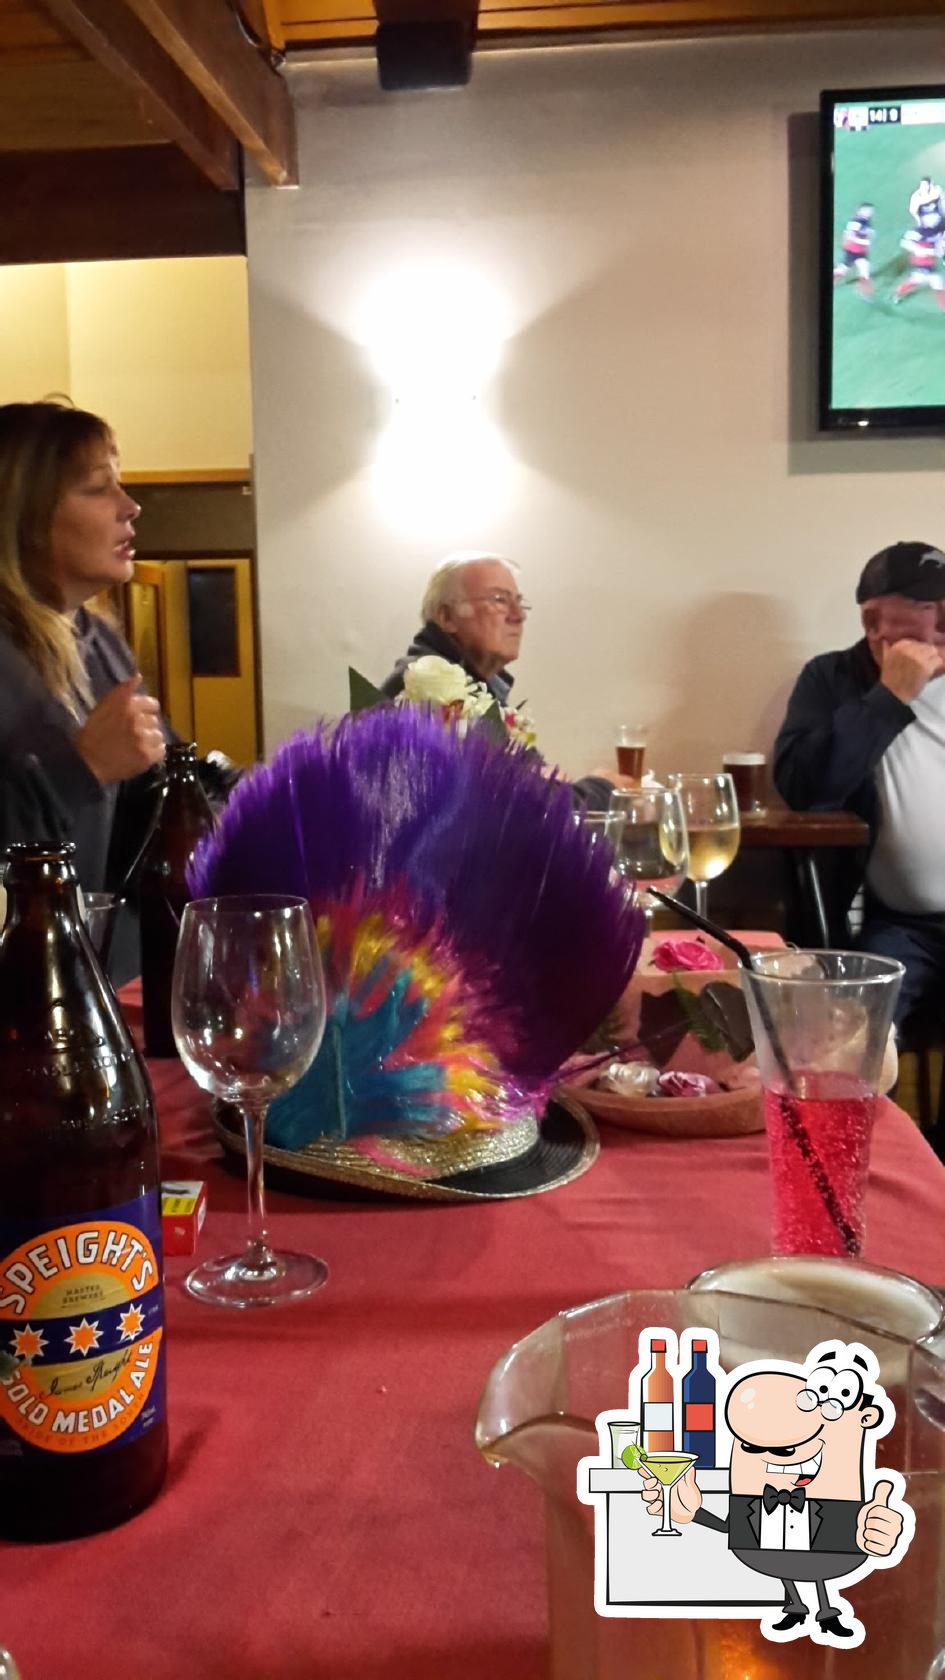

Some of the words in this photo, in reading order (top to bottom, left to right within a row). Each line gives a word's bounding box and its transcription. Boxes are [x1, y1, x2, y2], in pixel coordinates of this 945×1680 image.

[0, 1230, 153, 1315] SPEIGHT'S
[52, 1388, 135, 1433] MEDAL
[130, 1342, 153, 1389] ALE
